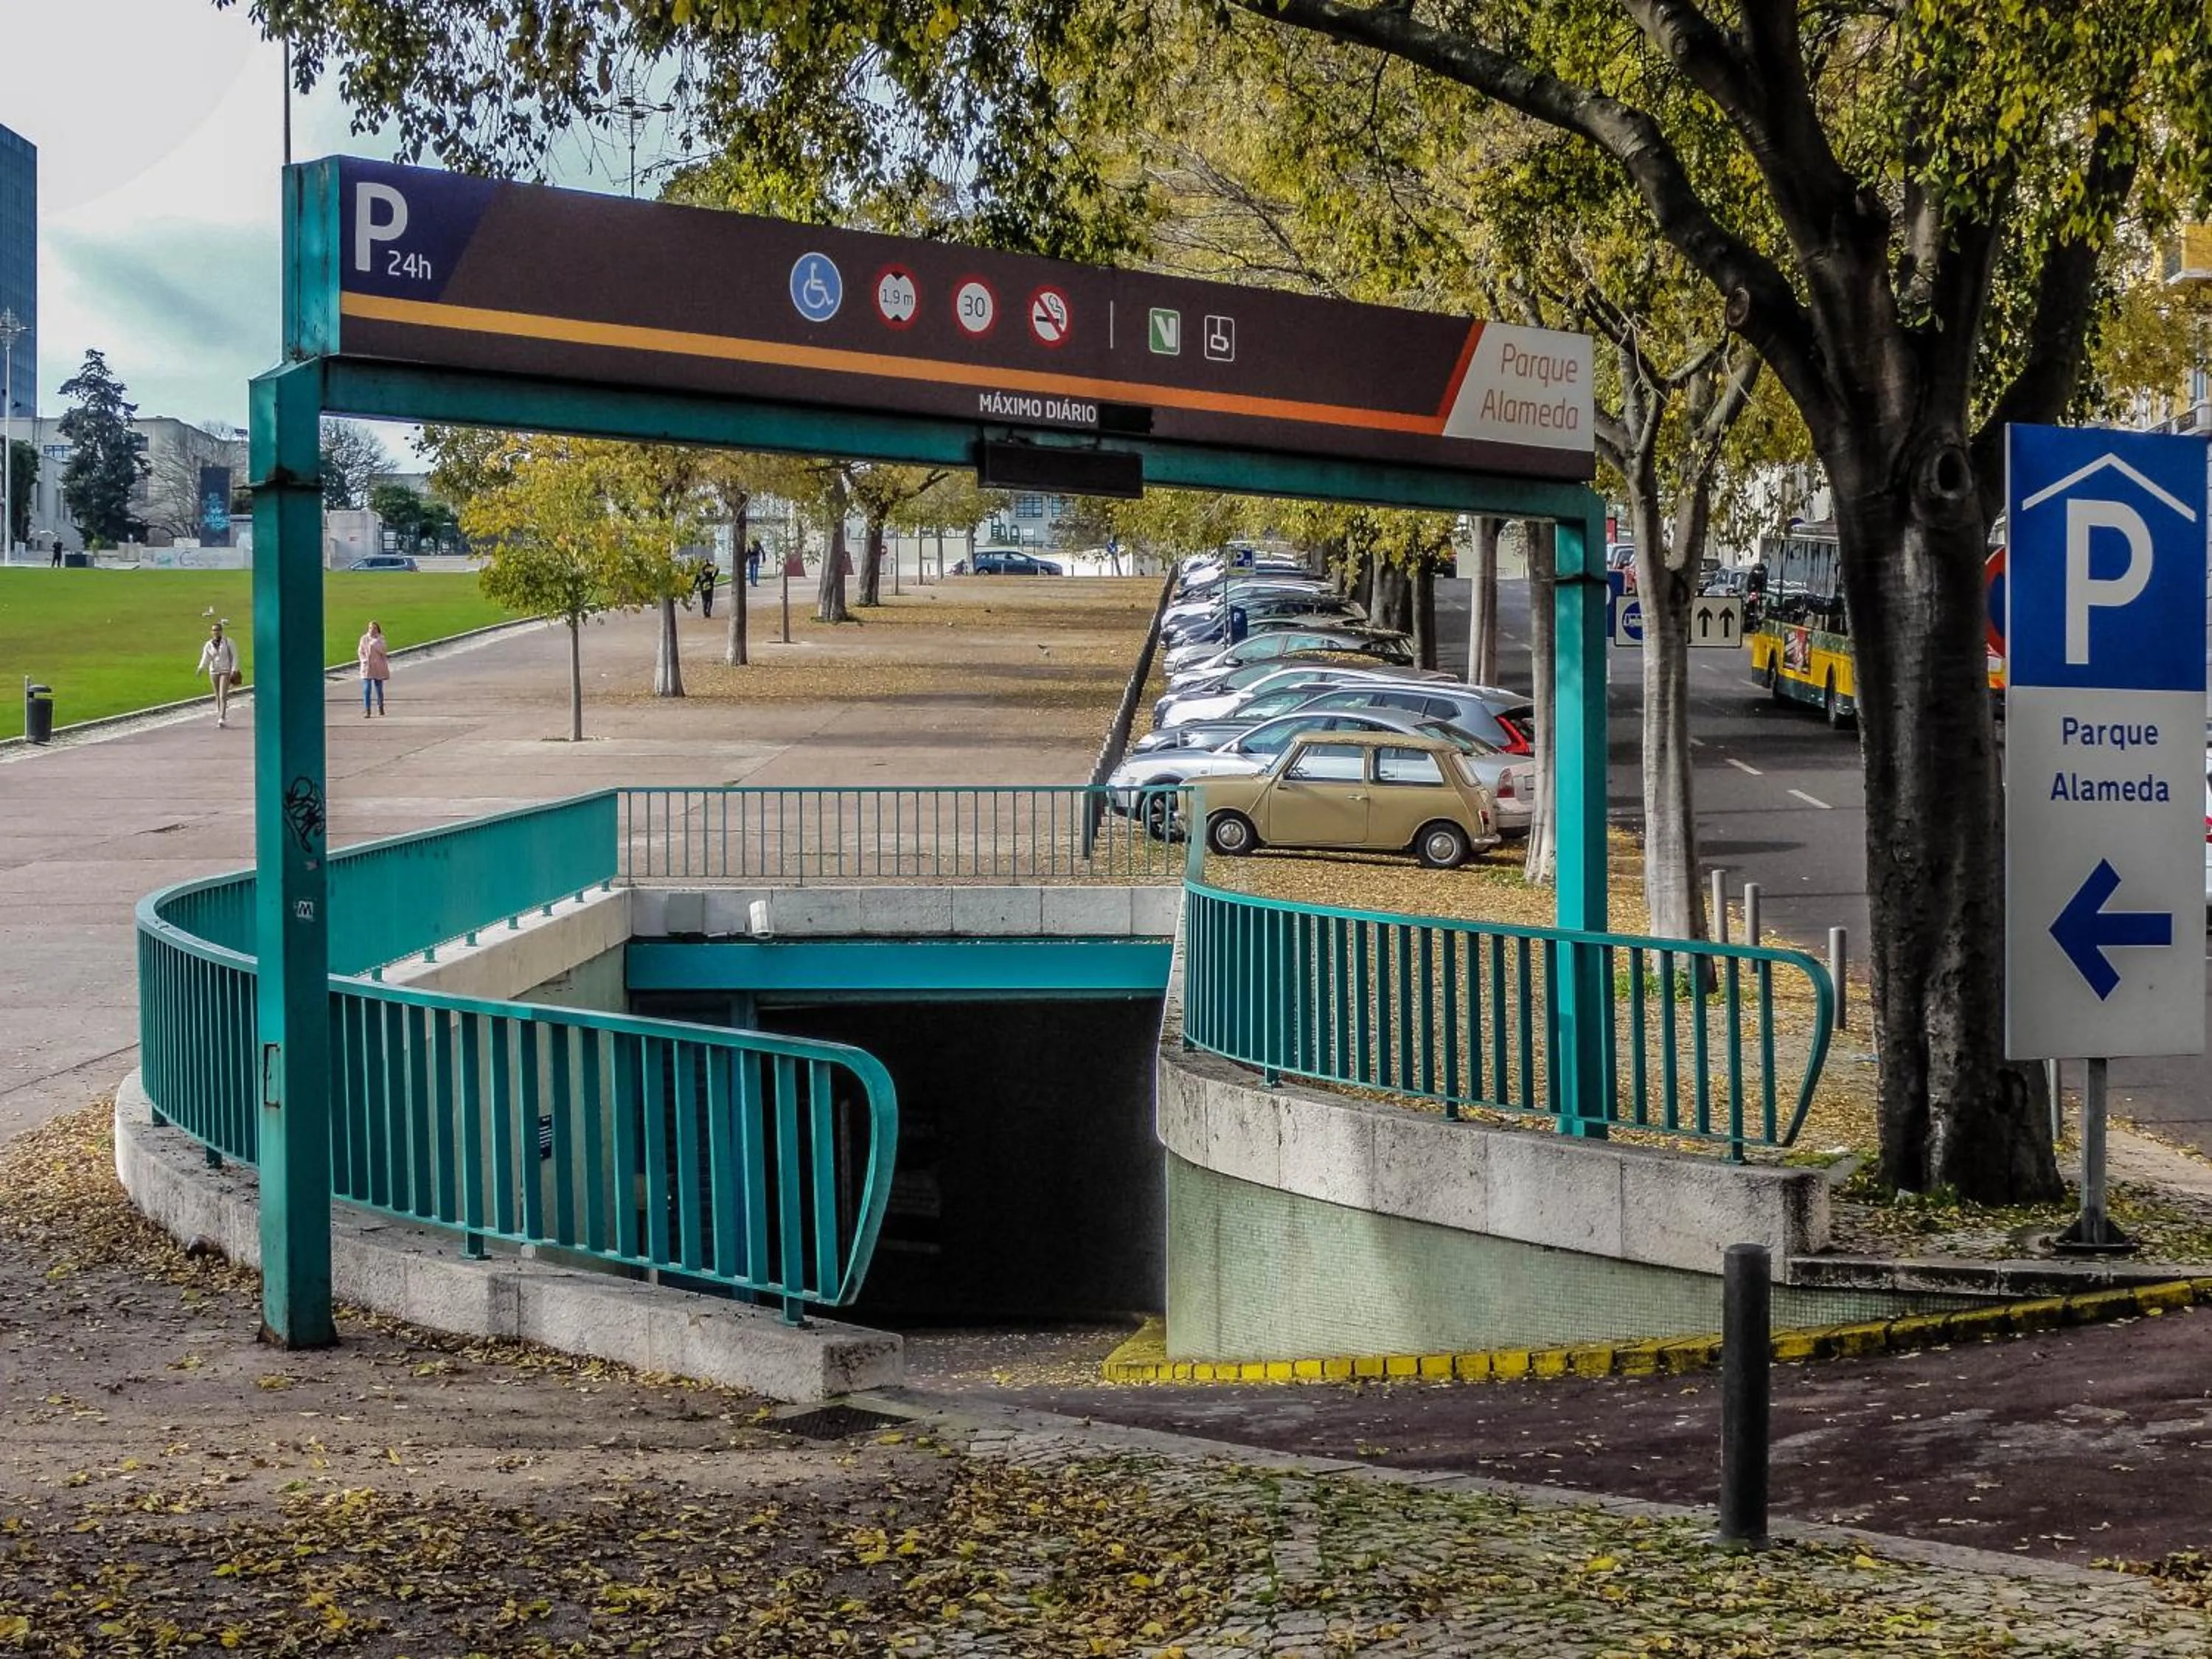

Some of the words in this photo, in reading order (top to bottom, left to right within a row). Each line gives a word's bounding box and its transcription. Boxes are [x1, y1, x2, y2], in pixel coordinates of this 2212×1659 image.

[355, 182, 408, 272] P
[387, 251, 431, 280] 24h
[964, 296, 986, 318] 30
[1501, 343, 1578, 387] Parque
[979, 392, 1041, 417] MÁXIMO
[1046, 398, 1096, 422] DIÁRIO
[1480, 389, 1578, 430] Alameda
[2066, 498, 2154, 664] P
[2062, 717, 2160, 751] Parque
[2051, 772, 2170, 803] Alameda
